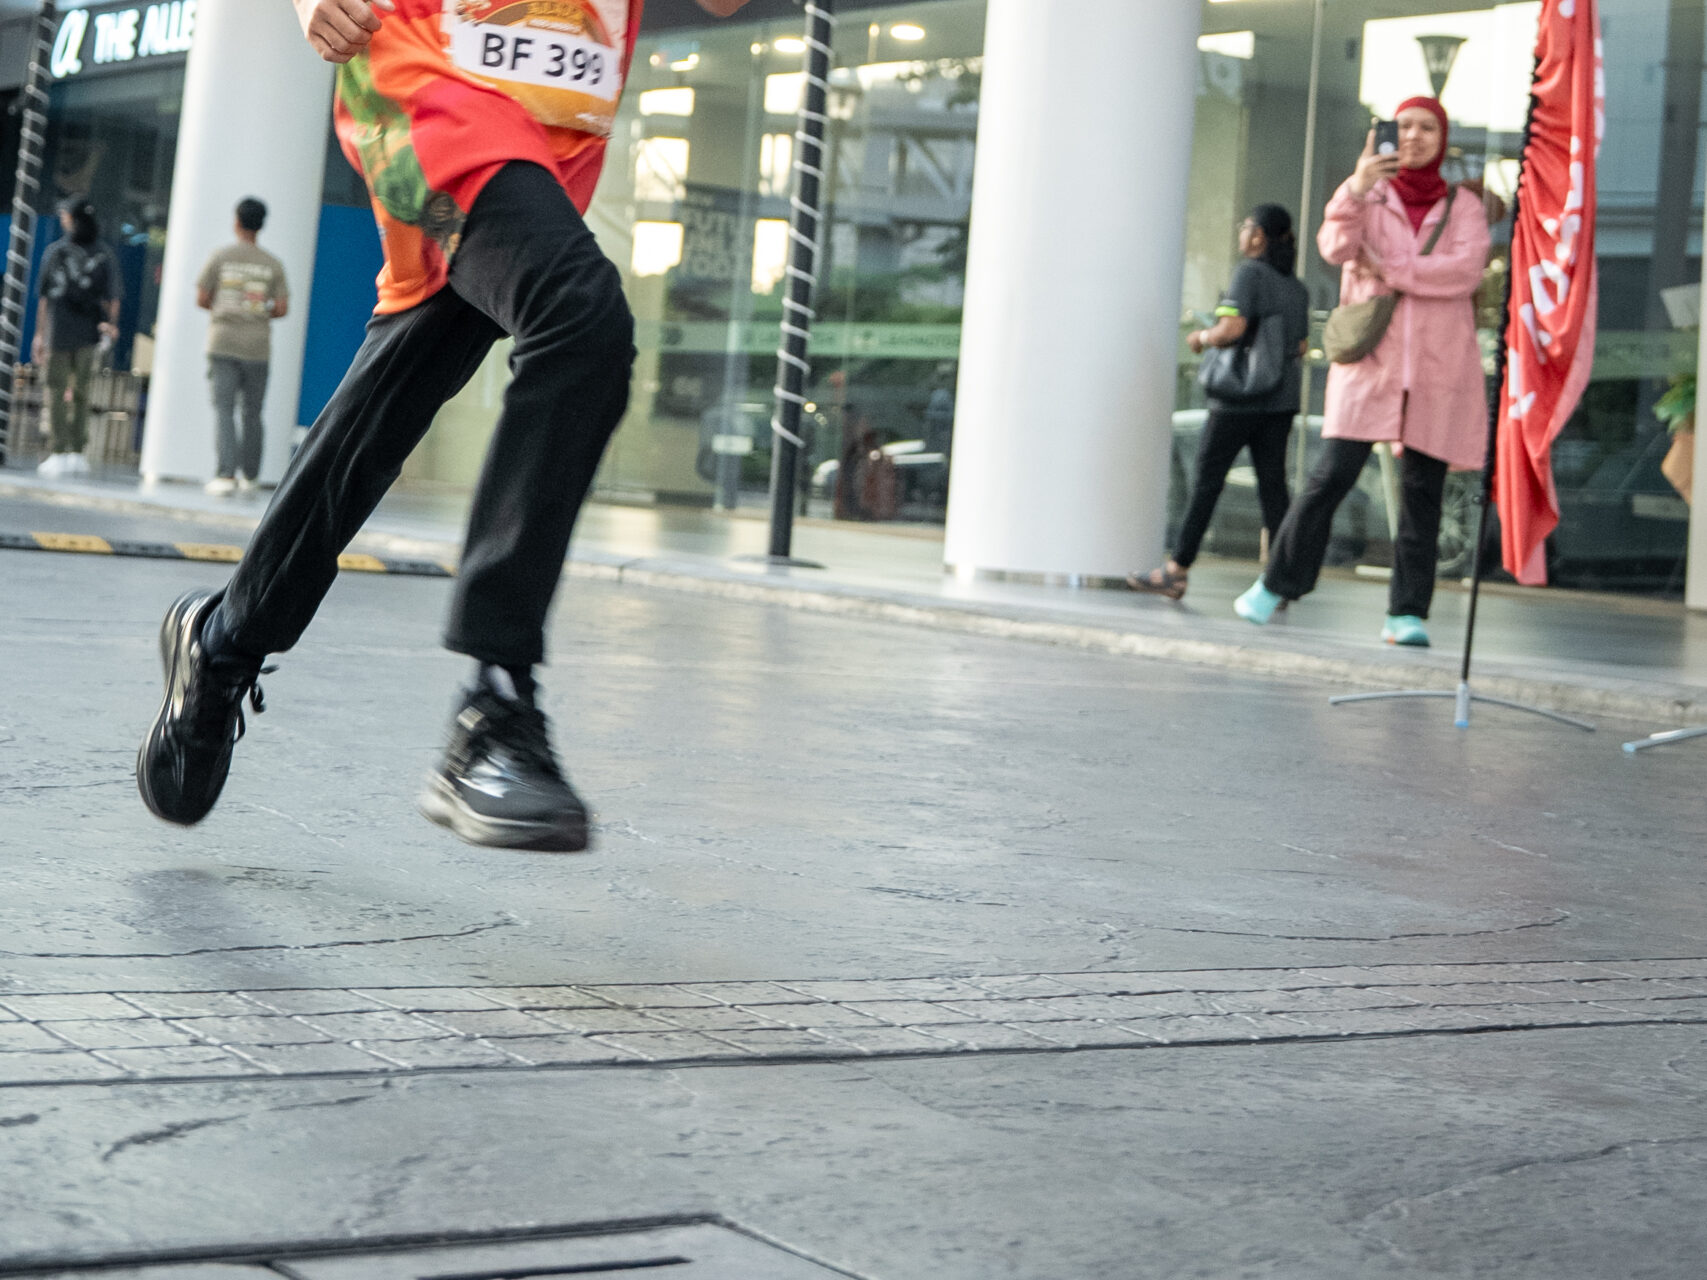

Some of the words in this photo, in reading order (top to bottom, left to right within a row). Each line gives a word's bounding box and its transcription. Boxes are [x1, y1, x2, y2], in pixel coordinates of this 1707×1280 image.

[93, 8, 140, 64] THE
[482, 32, 535, 70] BF
[545, 43, 604, 86] 399
